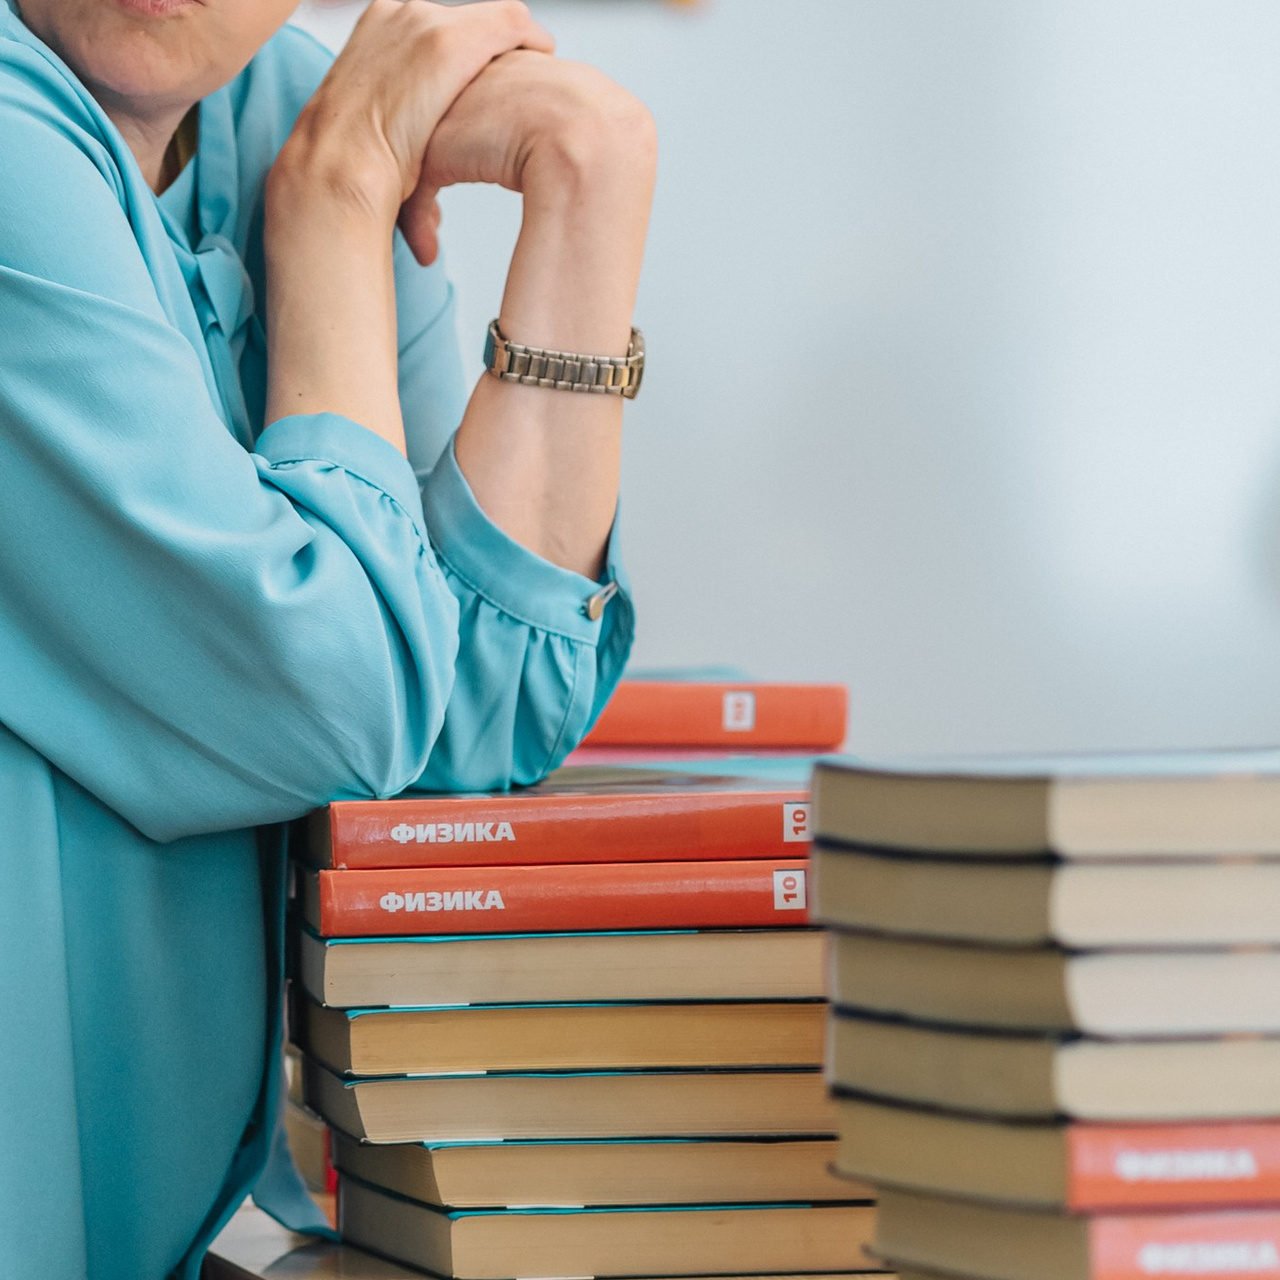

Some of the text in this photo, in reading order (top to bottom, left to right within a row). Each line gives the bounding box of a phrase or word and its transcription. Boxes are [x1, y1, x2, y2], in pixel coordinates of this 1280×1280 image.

[390, 822, 516, 844] ФИЗИКА
[792, 809, 807, 835] 10
[379, 890, 505, 913] ФИЗИКА
[783, 876, 798, 903] 10
